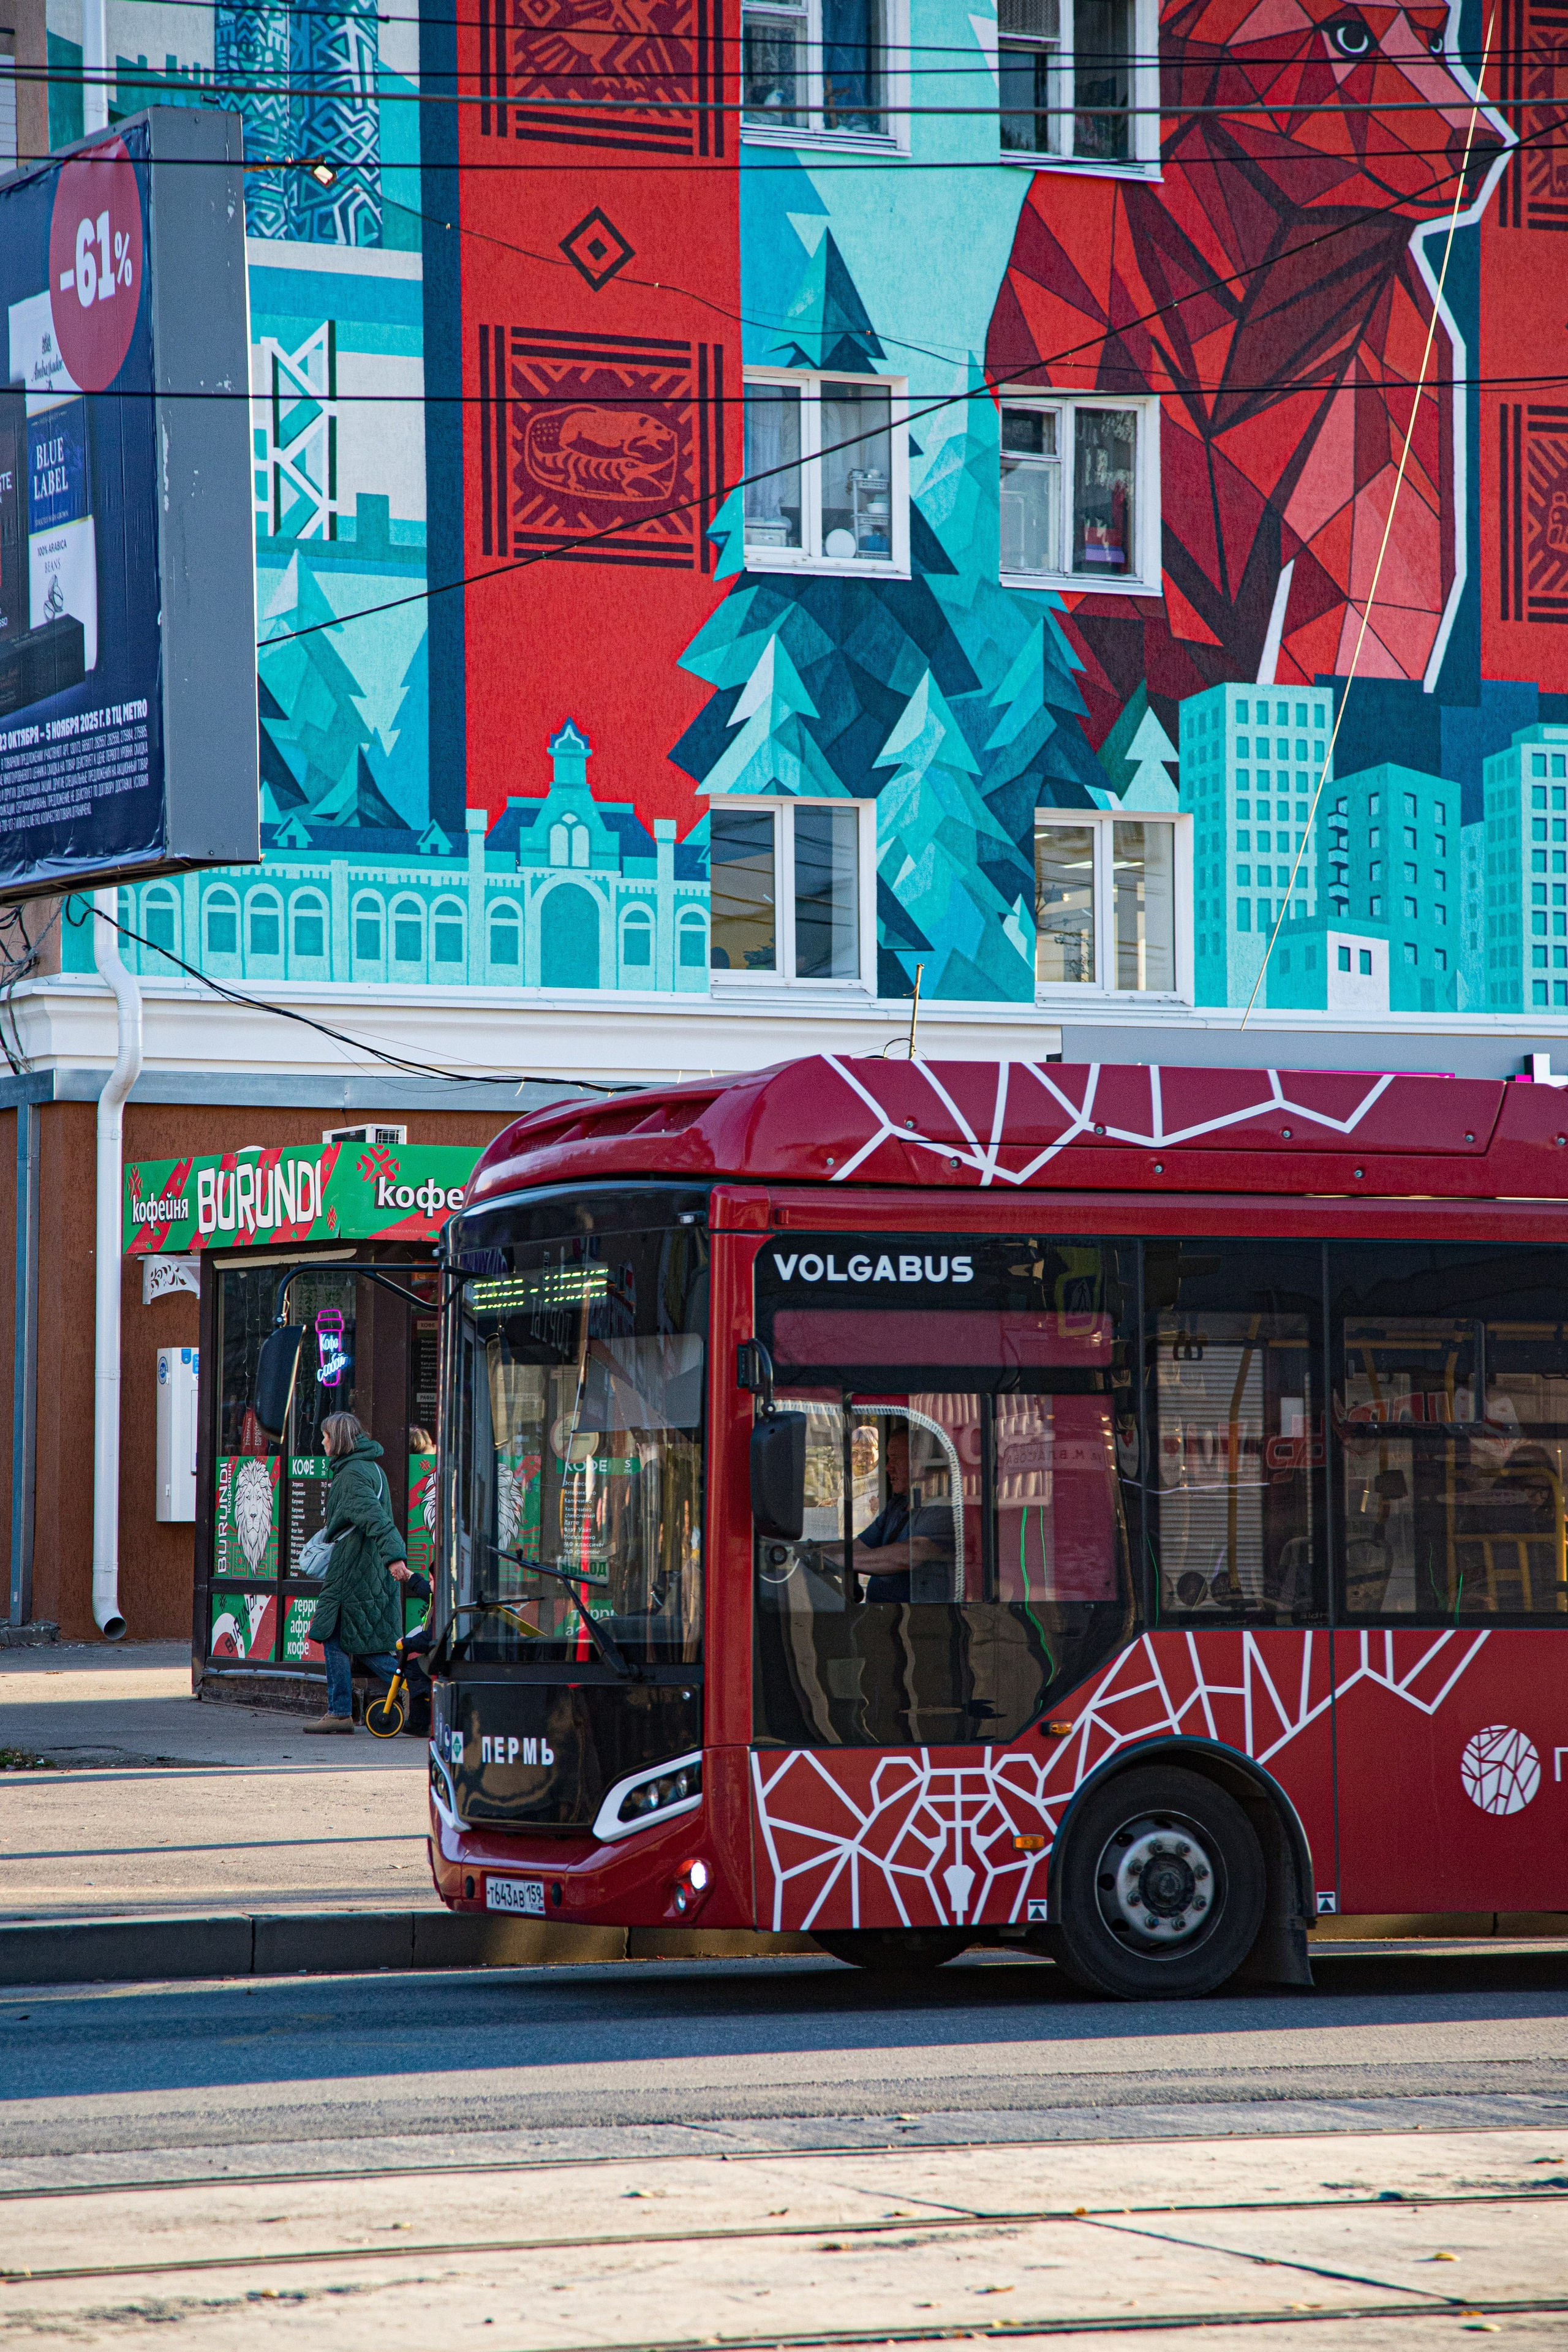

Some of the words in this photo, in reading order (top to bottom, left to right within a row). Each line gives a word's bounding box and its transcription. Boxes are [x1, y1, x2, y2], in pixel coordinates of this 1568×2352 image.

[60, 210, 132, 307] -61%
[36, 437, 64, 470] BLUE
[34, 466, 69, 501] LABEL
[48, 538, 67, 554] ARABICA
[45, 558, 61, 573] BEANS
[7, 725, 39, 750] ОКТЯБРЯ
[45, 722, 51, 741] 5
[51, 715, 79, 739] НОЯБРЯ
[80, 710, 98, 733] 2025
[99, 709, 105, 728] Г.
[105, 707, 111, 726] В
[111, 705, 122, 727] ТЦ
[123, 699, 147, 722] METRO
[132, 1192, 188, 1229] кофейня
[198, 1159, 322, 1235] BURUNDI
[379, 1177, 464, 1217] кофе
[774, 1254, 974, 1283] VOLGABUS
[320, 1333, 339, 1353] Кофе
[292, 1459, 314, 1475] КОФЕ
[218, 1463, 228, 1574] BURUNDI
[224, 1595, 257, 1653] BURUNDI
[287, 1637, 309, 1659] кофе
[481, 1736, 554, 1765] ПЕРМЬ
[490, 1883, 525, 1907] Т643АВ
[526, 1885, 541, 1903] 159
